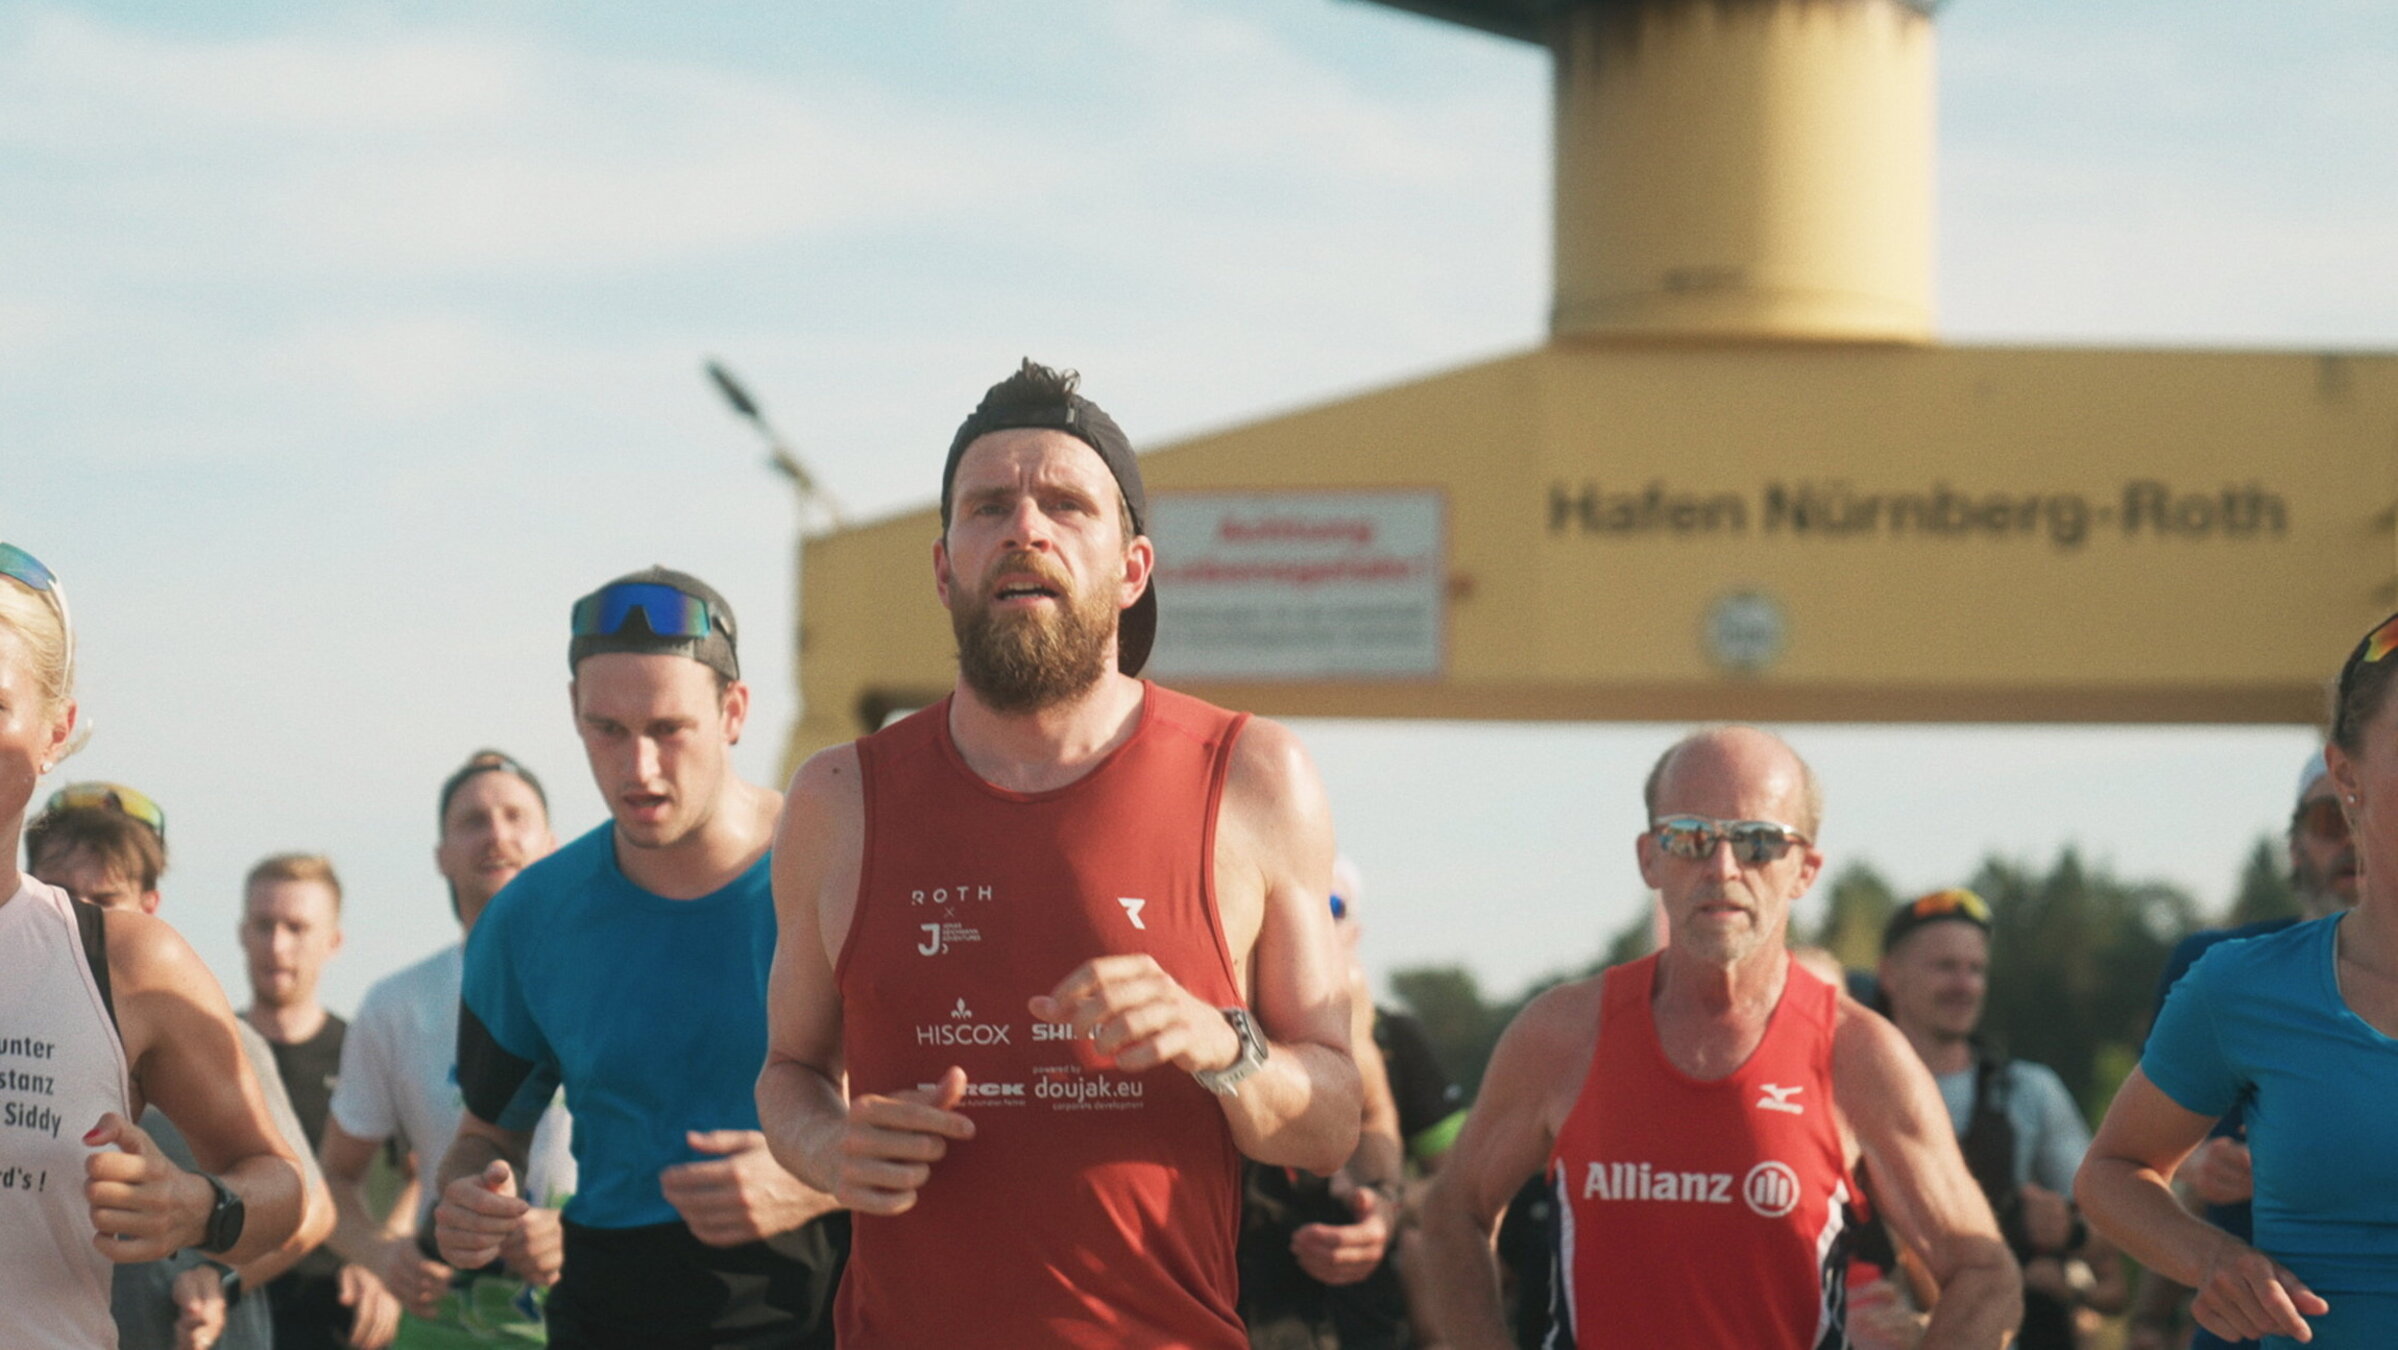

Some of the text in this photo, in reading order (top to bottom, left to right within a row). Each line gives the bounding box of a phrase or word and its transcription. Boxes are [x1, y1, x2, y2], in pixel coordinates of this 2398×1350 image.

[1549, 480, 2288, 548] Hafen Nürnberg-Roth
[911, 886, 992, 905] ROTH
[916, 1024, 1010, 1045] HISCOX
[1034, 1074, 1142, 1103] doujak.eu
[4, 1102, 61, 1139] Siddy
[1584, 1162, 1733, 1203] Allianz
